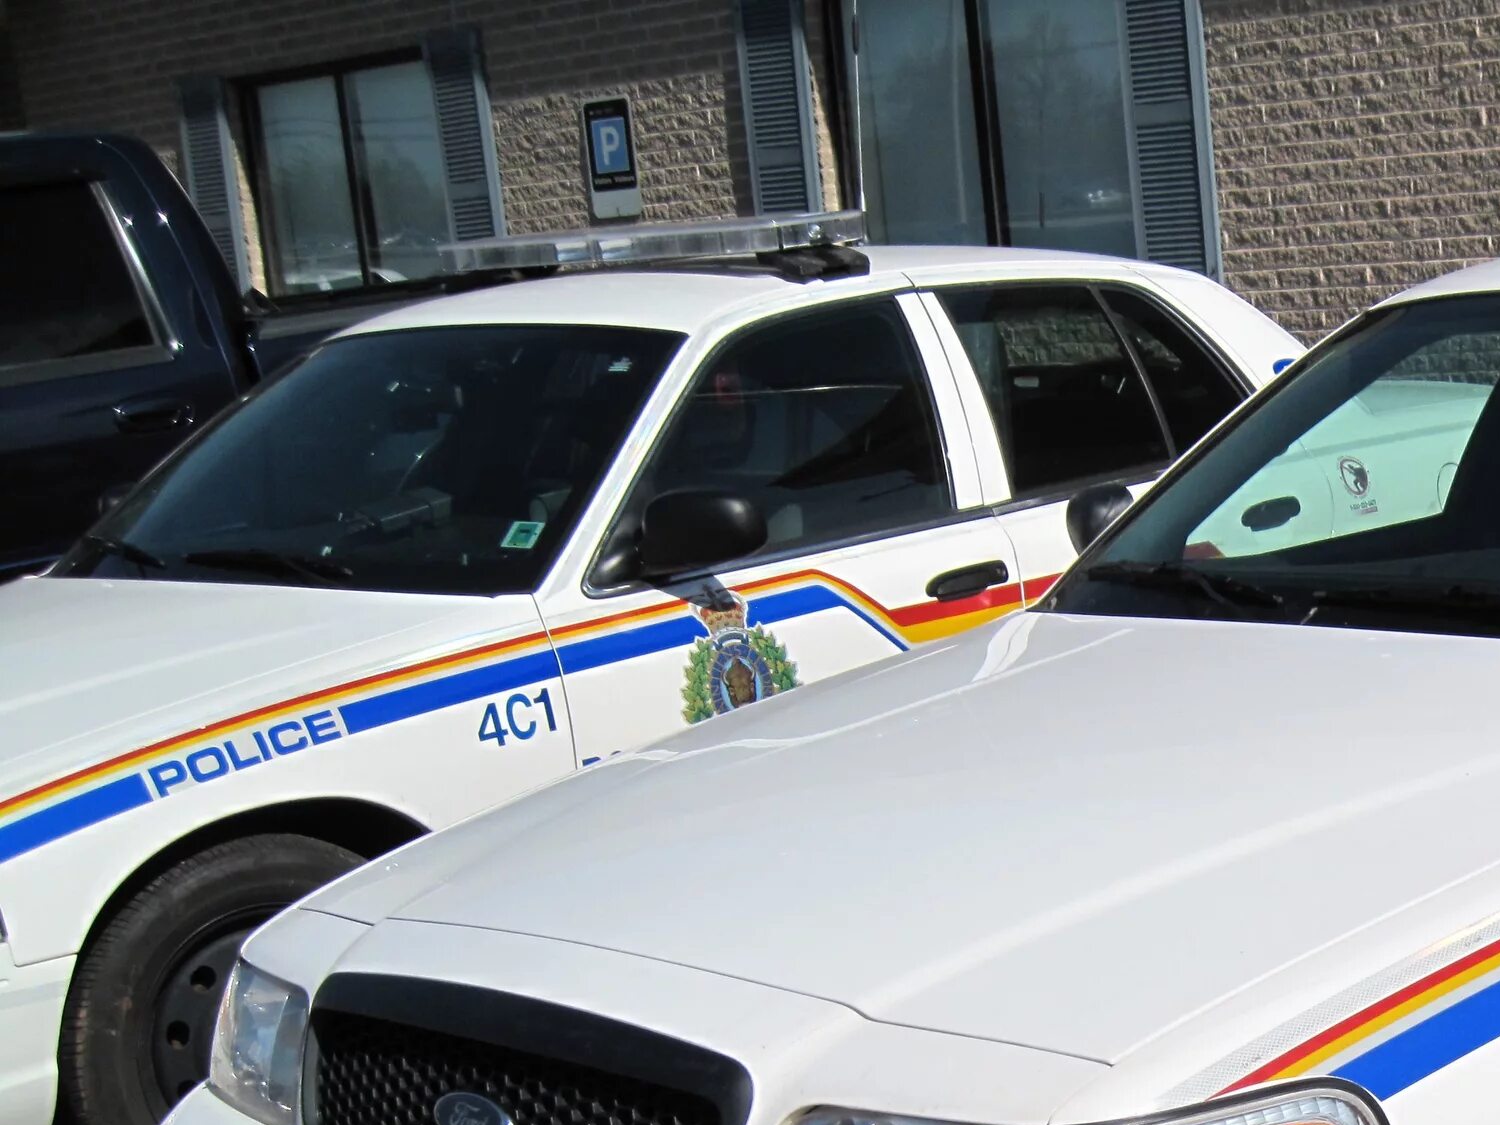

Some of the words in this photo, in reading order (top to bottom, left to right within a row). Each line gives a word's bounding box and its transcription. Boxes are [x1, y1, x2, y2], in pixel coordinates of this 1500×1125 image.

[600, 126, 620, 166] P
[478, 688, 558, 747] 4C1
[147, 709, 342, 797] POLICE
